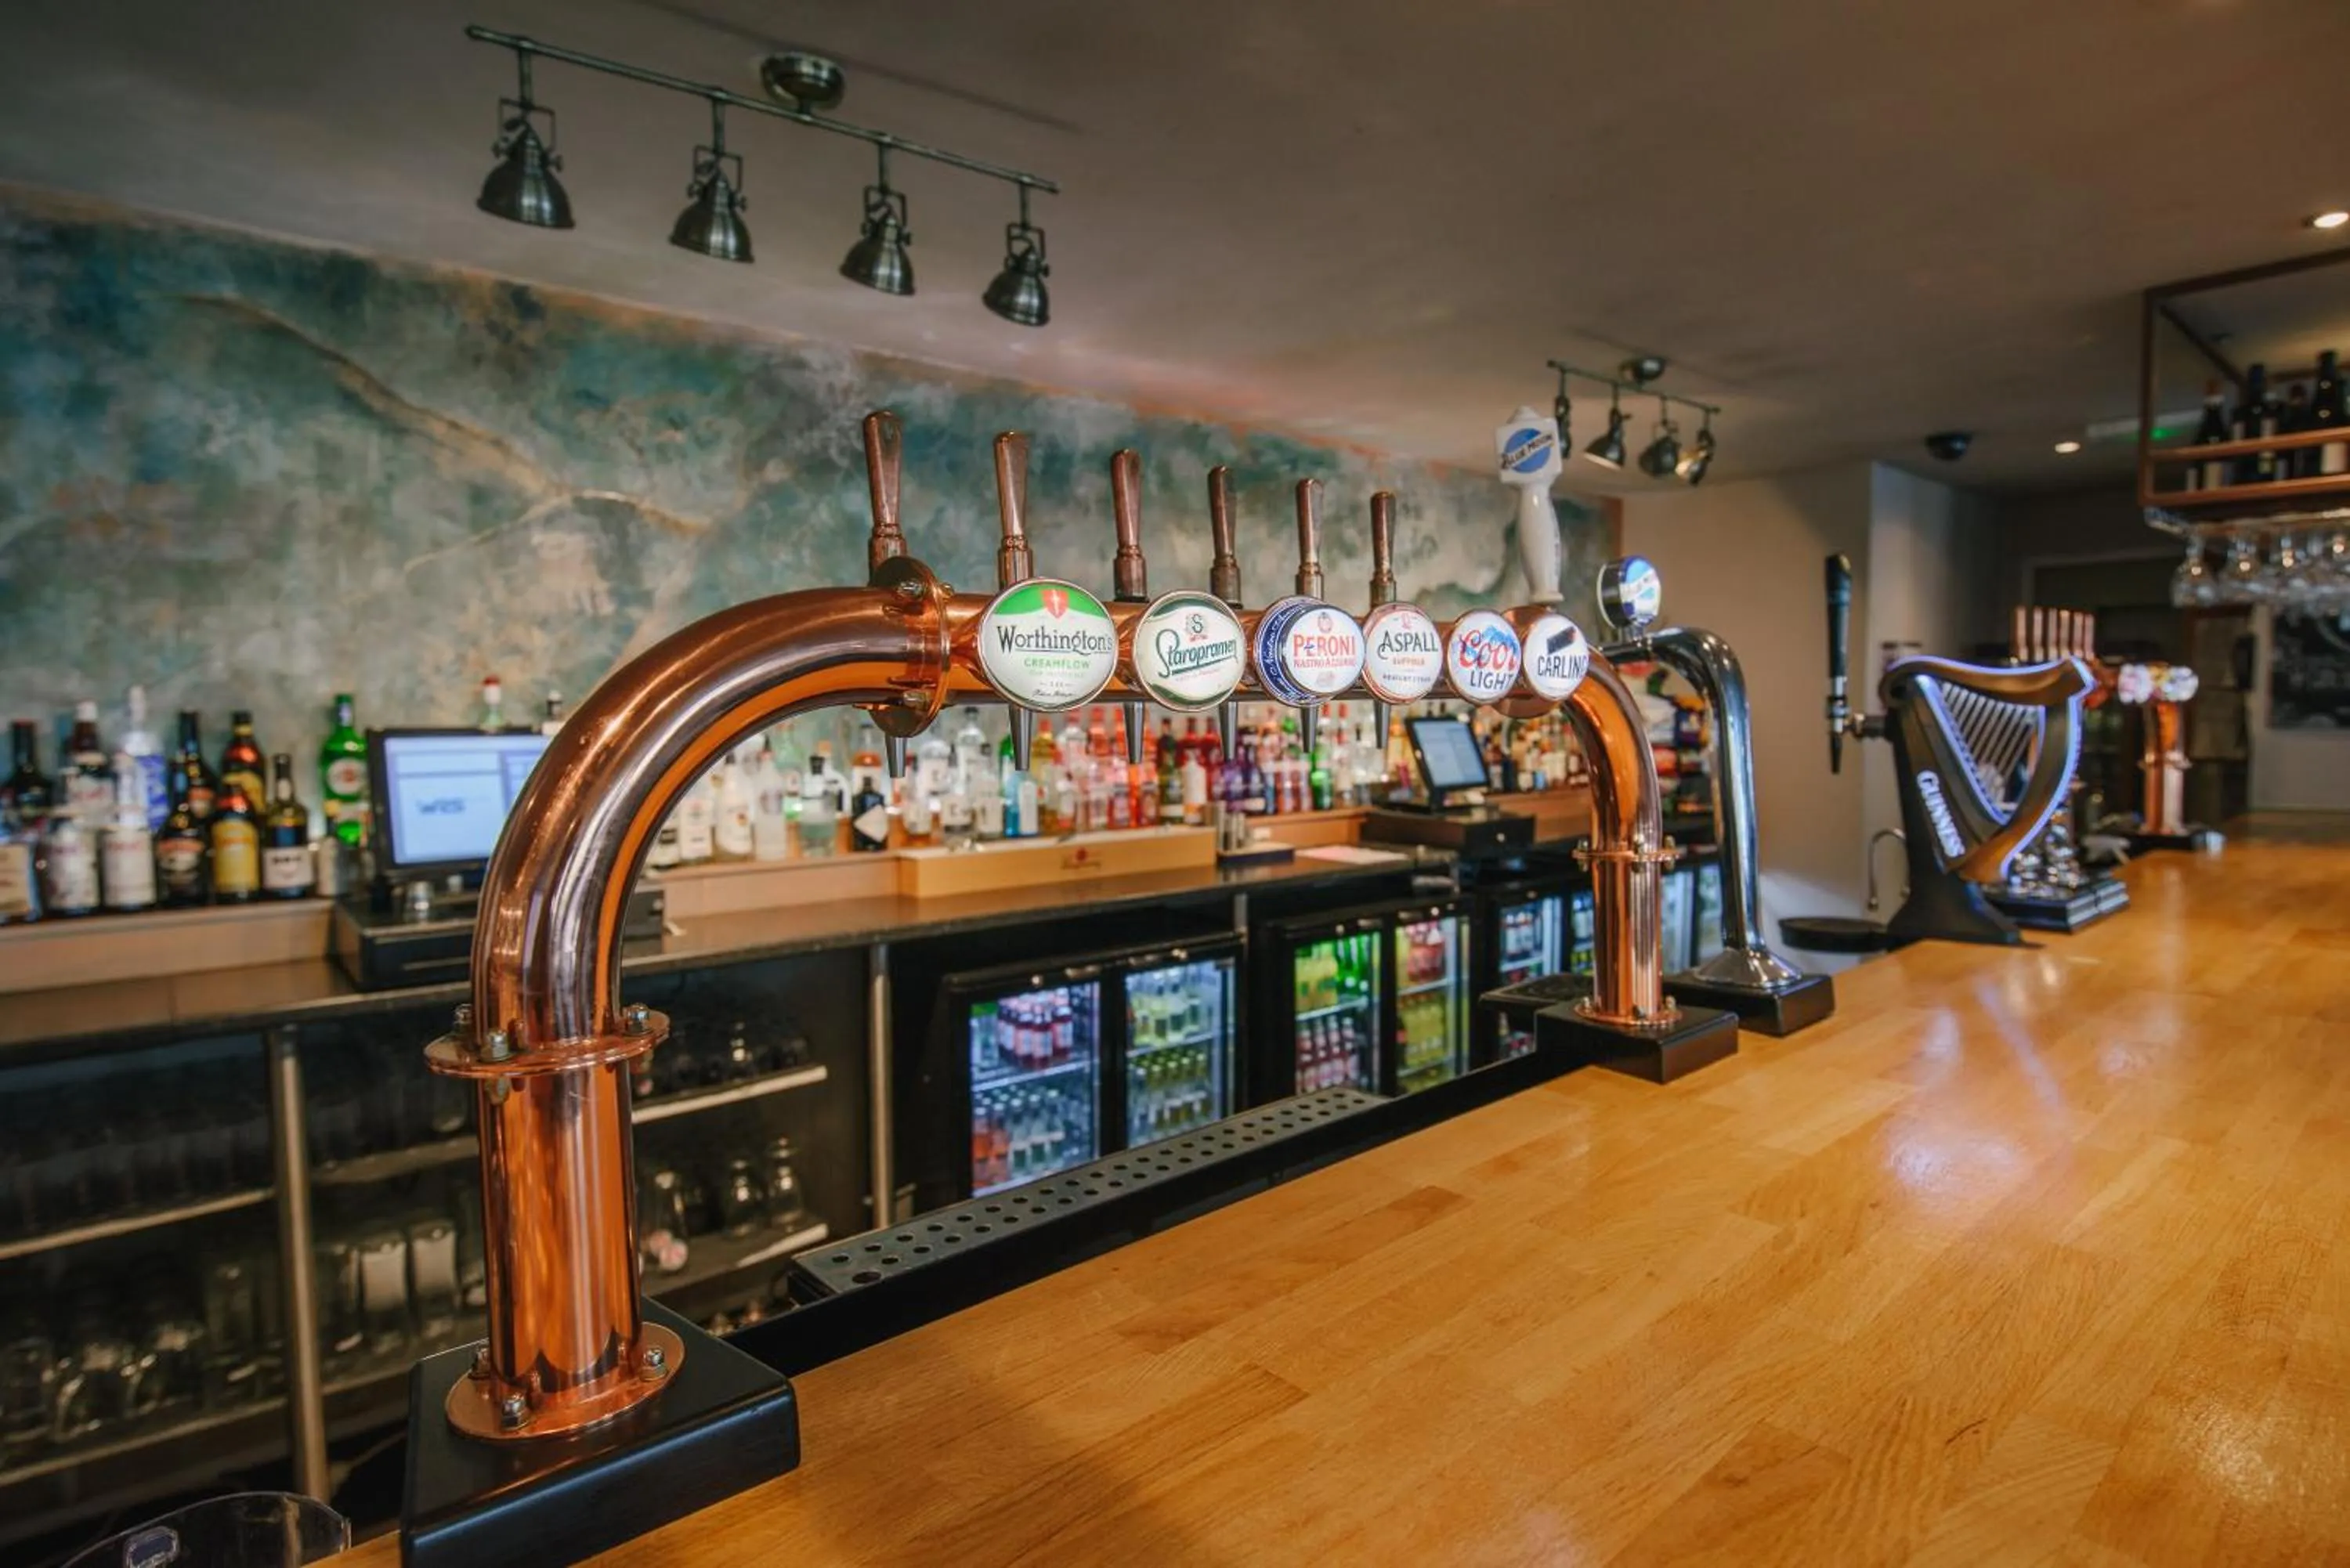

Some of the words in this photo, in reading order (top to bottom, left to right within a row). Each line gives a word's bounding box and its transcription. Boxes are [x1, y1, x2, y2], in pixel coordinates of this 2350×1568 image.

[996, 625, 1113, 656] Worthington's
[1155, 628, 1238, 678] Staropramen
[1293, 634, 1356, 657] PERONI
[1377, 630, 1438, 660] ASPALL
[1024, 656, 1090, 669] CREAMFLOW
[1470, 670, 1514, 689] LIGHT
